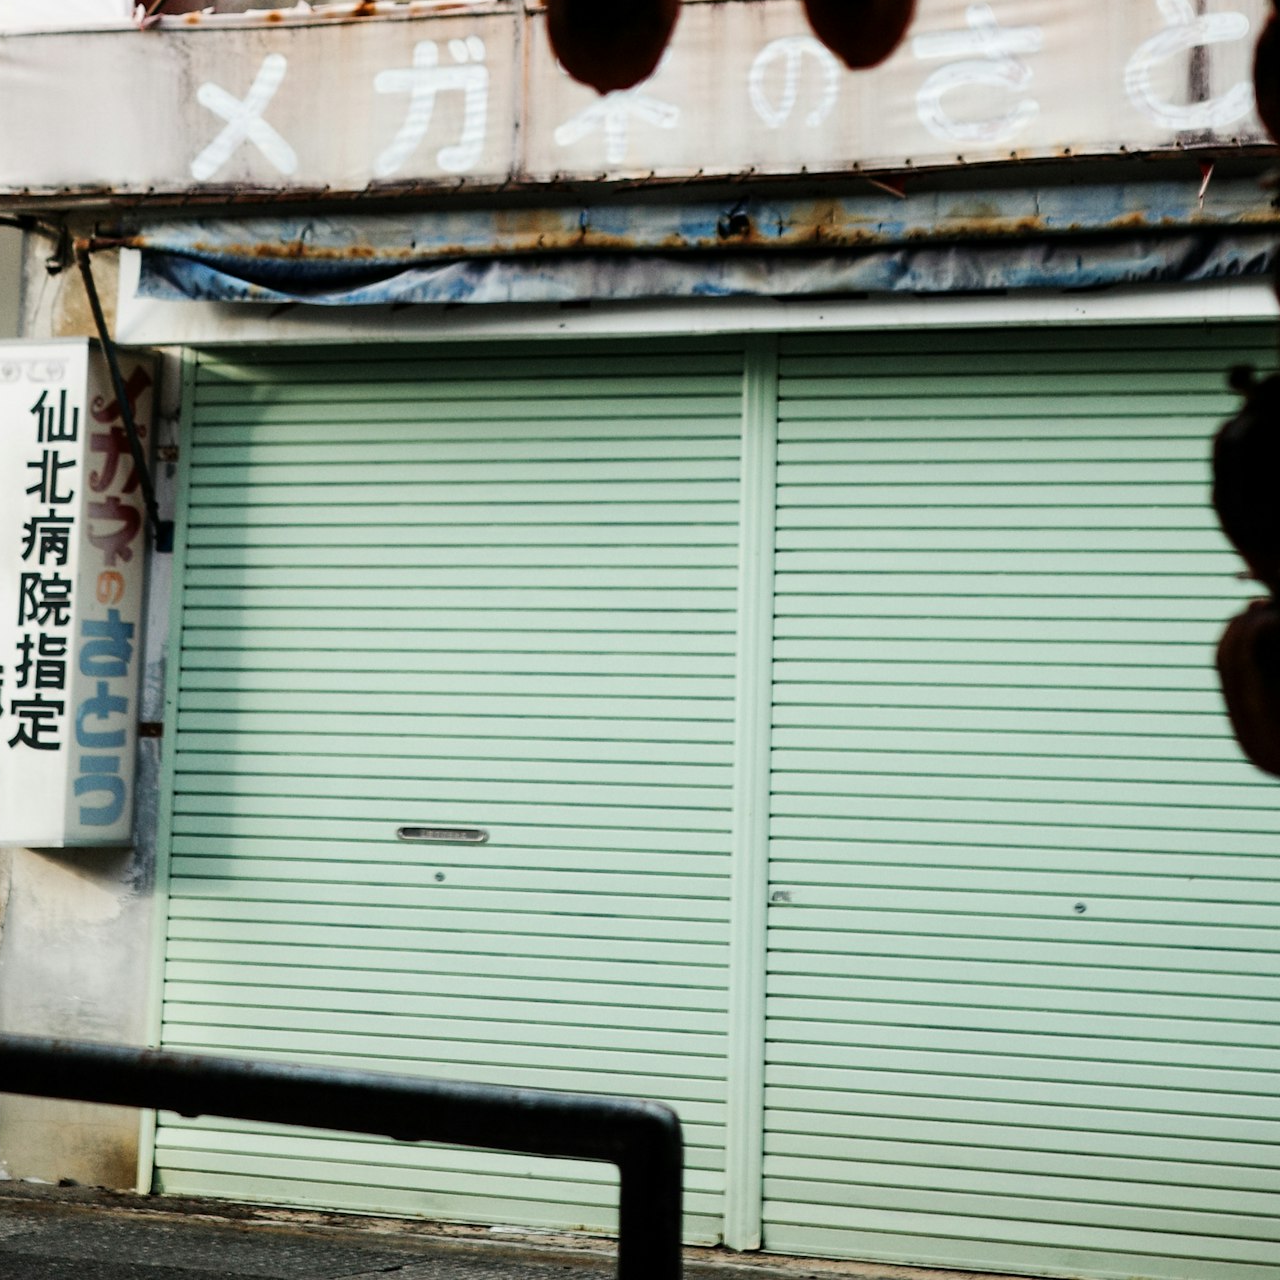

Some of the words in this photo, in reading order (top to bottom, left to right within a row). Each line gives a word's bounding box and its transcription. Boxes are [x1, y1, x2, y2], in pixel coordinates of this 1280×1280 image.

[8, 389, 79, 751] 仙北病院指定
